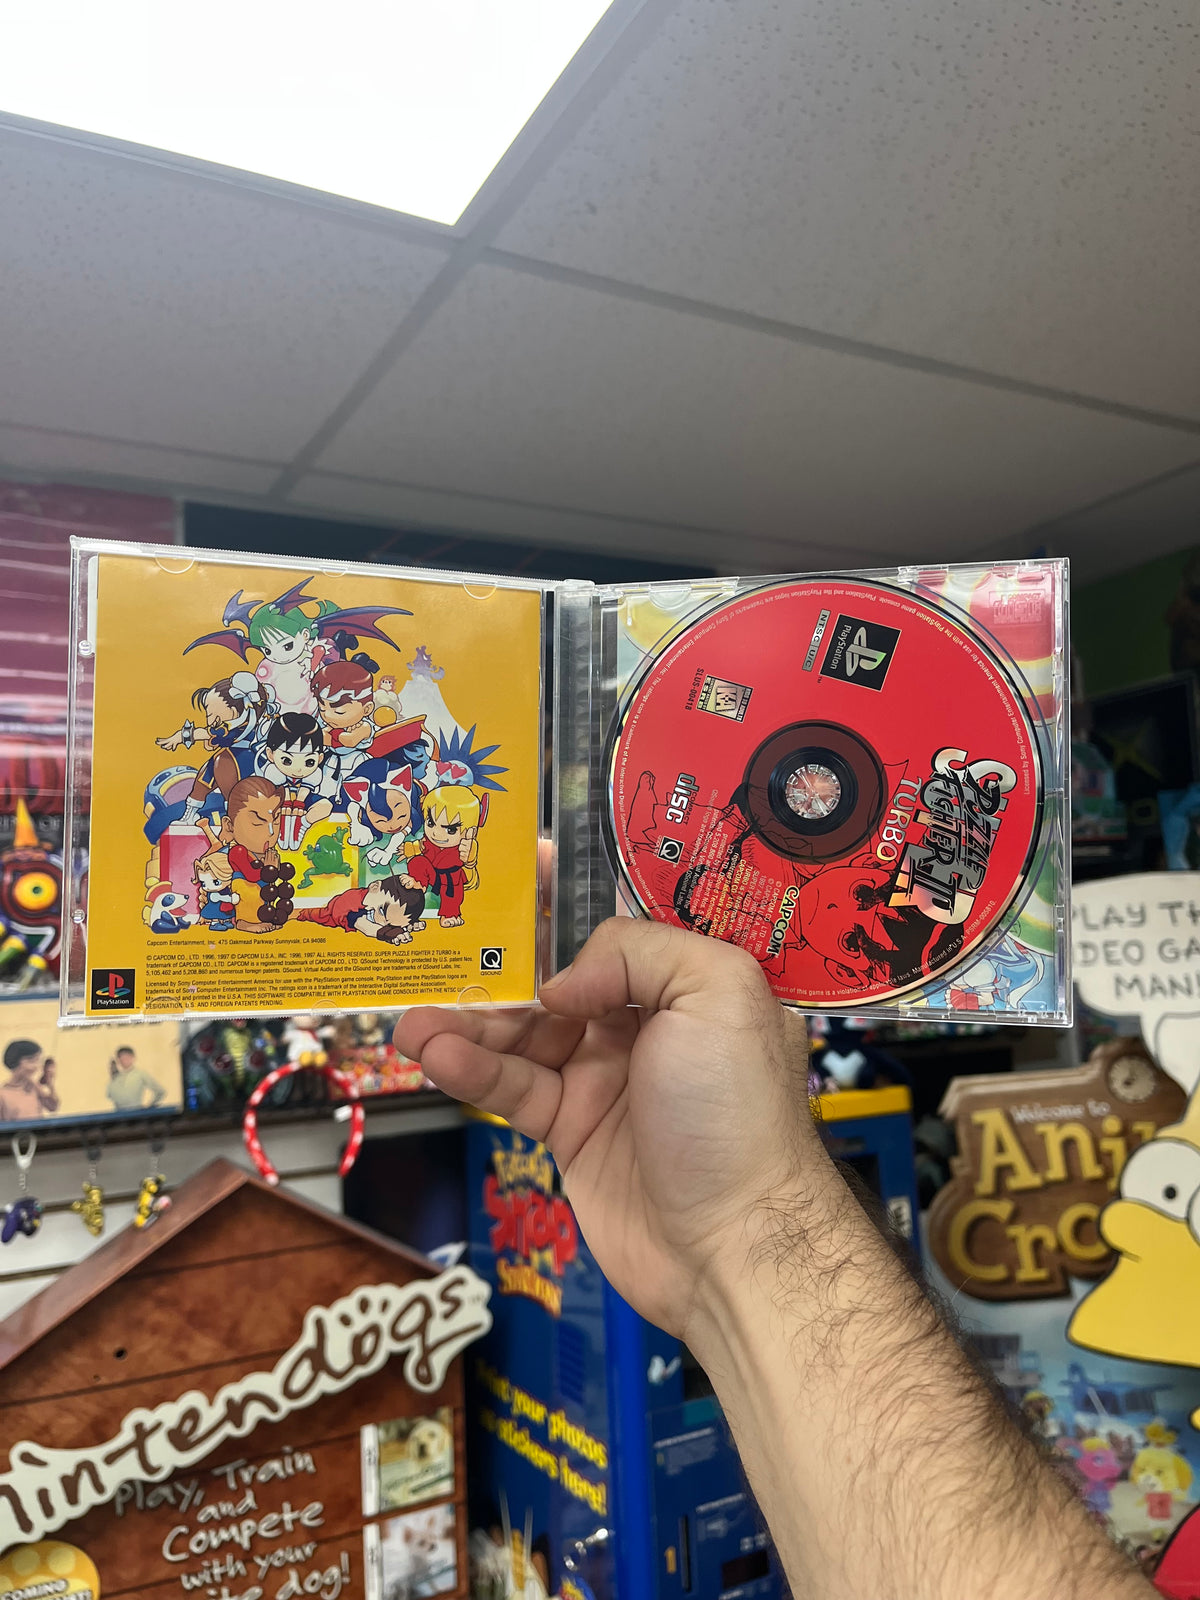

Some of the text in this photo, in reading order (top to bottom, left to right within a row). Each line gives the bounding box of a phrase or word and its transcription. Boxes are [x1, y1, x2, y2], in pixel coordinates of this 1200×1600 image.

[805, 614, 828, 668] NTSC U/C
[915, 610, 945, 631] PlayStation
[830, 624, 852, 670] PlayStation
[975, 659, 994, 680] America
[685, 668, 704, 710] SLUS-00418
[1018, 743, 1027, 759] Sony
[665, 772, 700, 825] disc
[876, 776, 922, 861] TURBO
[920, 768, 966, 867] FIGHTER
[962, 766, 1002, 890] PUZZLE
[716, 858, 746, 935] CAPCOM CAPCOM
[741, 864, 752, 885] TURBO
[765, 883, 799, 956] CAPCOM
[767, 887, 780, 913] CAPCOM
[1073, 938, 1144, 966] DEO
[1011, 1098, 1112, 1124] Welcome to
[970, 1108, 1158, 1197] Ani
[211, 1446, 317, 1490] Train
[196, 1490, 258, 1523] and
[162, 1500, 325, 1562] Compete
[181, 1541, 318, 1590] with your
[275, 1551, 350, 1600] dog!
